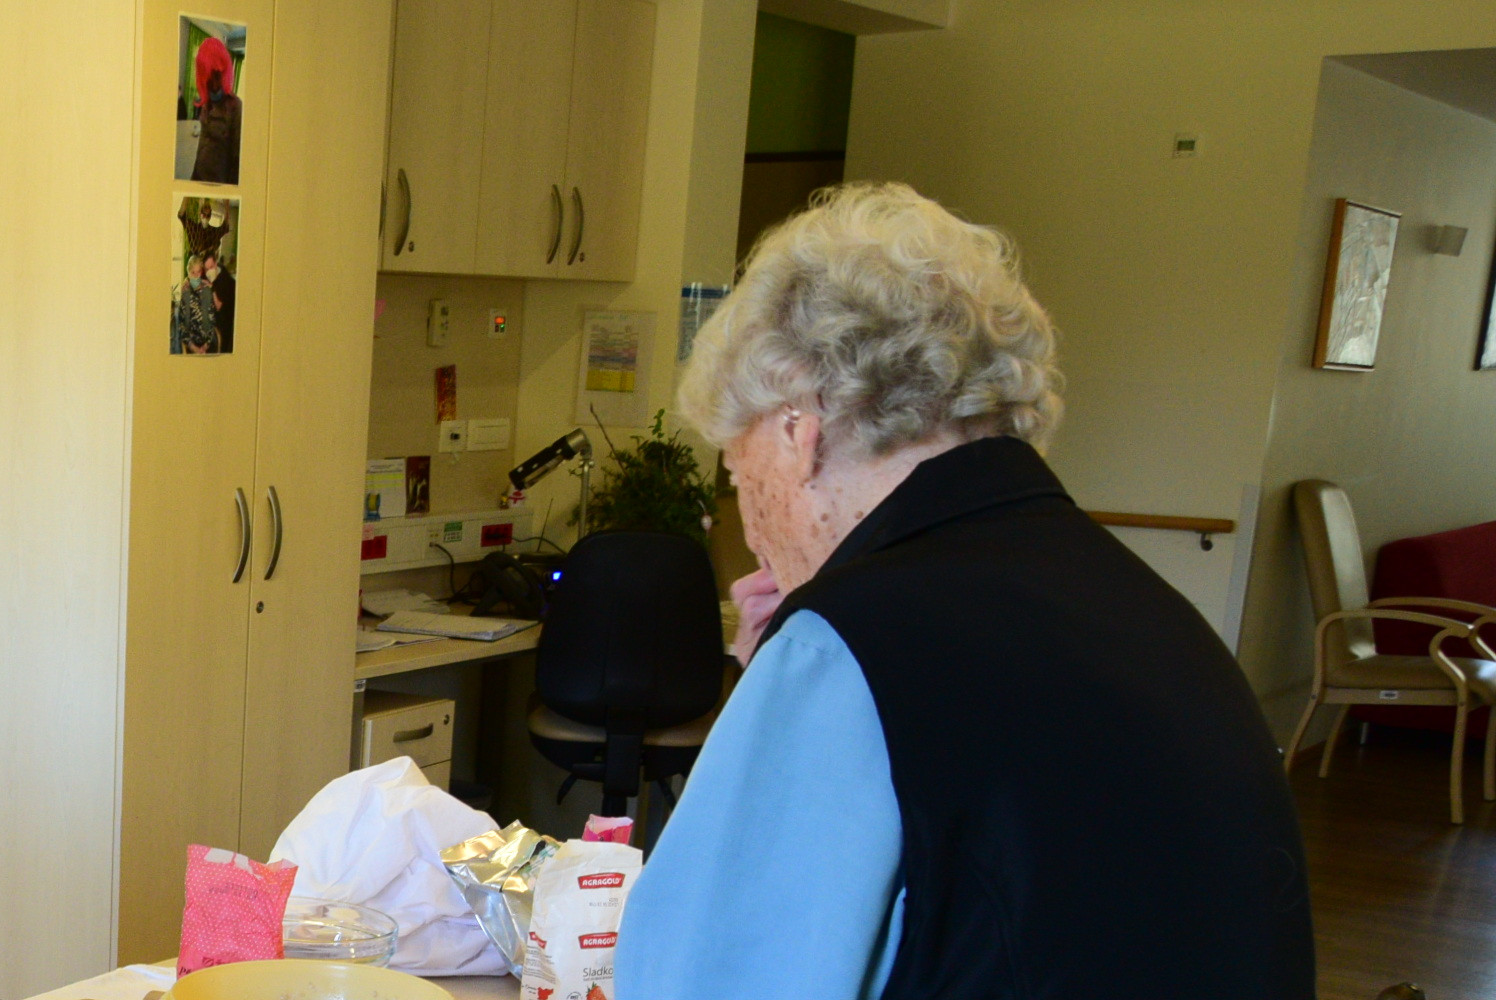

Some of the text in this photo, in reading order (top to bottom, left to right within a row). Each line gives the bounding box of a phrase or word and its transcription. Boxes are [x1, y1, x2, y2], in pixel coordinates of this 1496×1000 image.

[582, 877, 621, 886] AGRAGOLD
[583, 937, 616, 946] AGRAGOLD
[582, 966, 614, 978] Sladko
